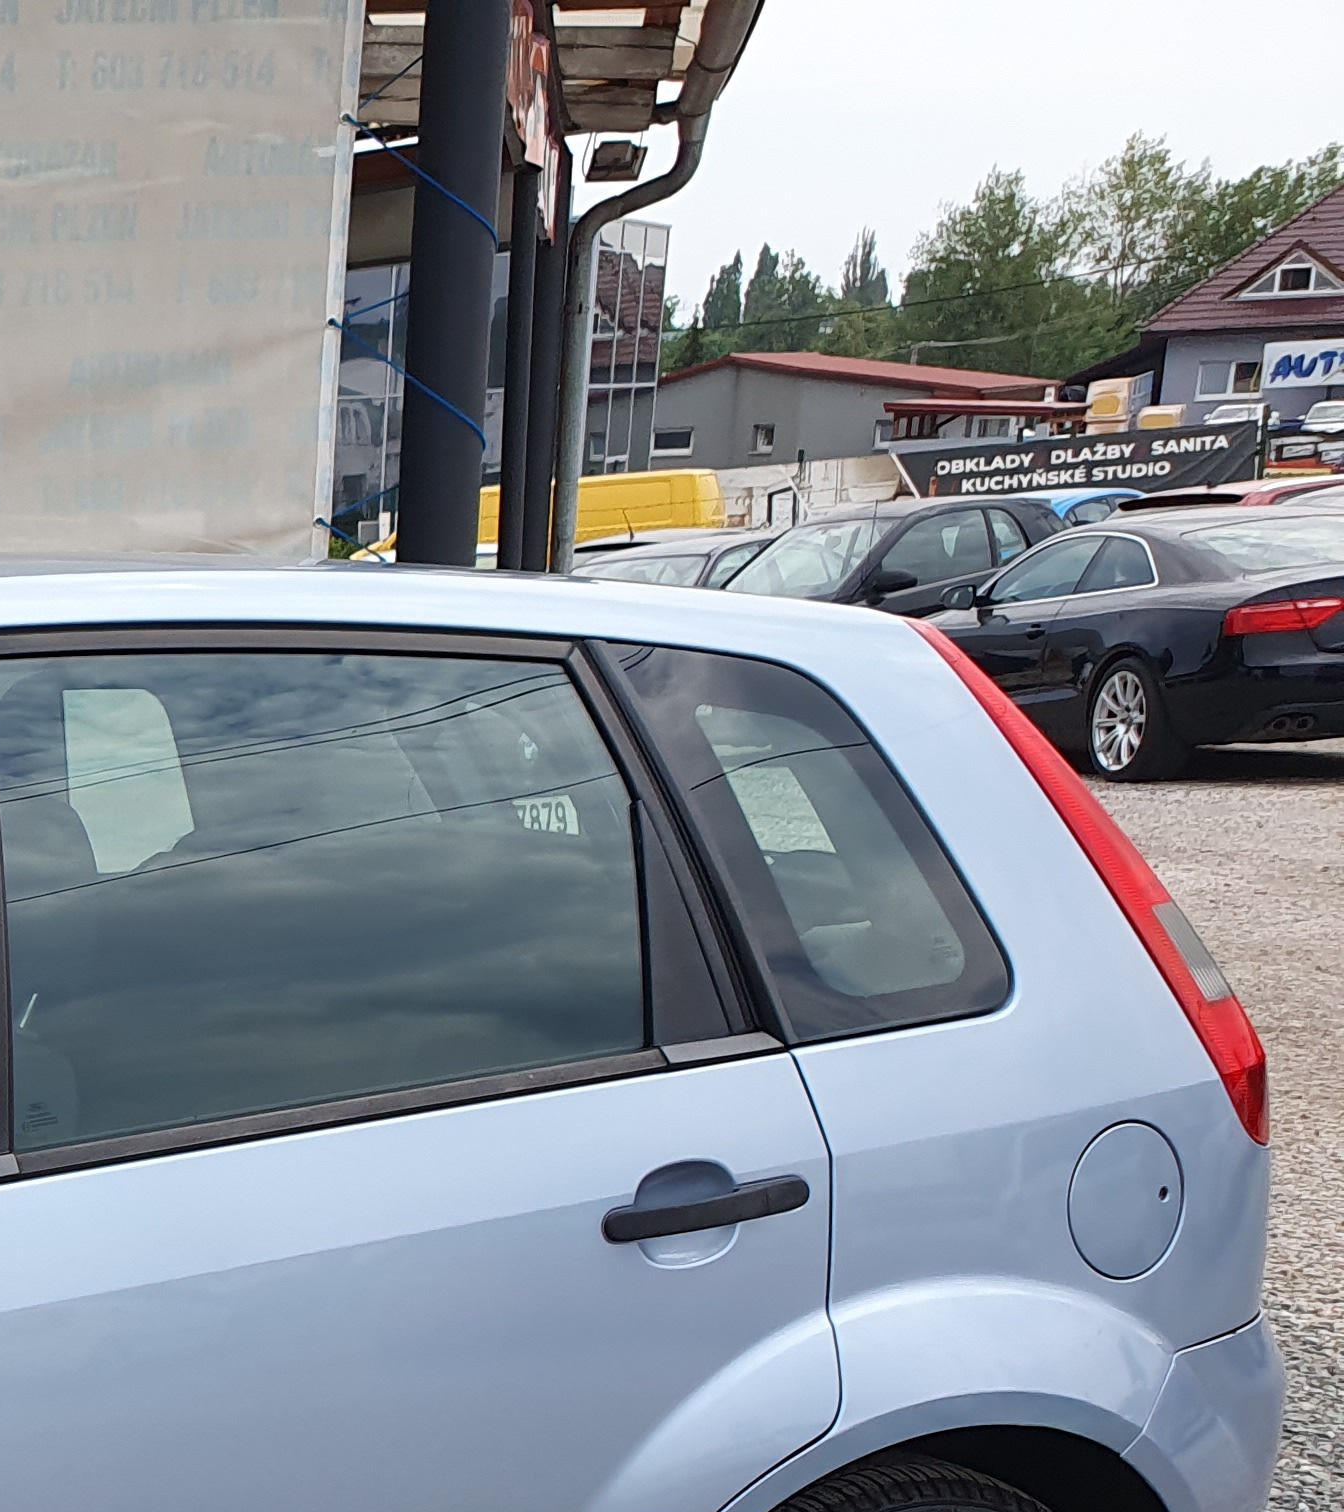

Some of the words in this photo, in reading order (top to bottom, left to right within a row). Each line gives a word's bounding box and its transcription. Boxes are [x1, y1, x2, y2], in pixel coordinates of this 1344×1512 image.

[1269, 350, 1344, 384] AUT
[936, 452, 1034, 476] OBKLADY
[1050, 442, 1136, 465] DLAŽBY
[1150, 434, 1230, 456] SANITA
[961, 466, 1087, 493] KUCHYŇSKÉ
[1091, 460, 1172, 483] STUDIO
